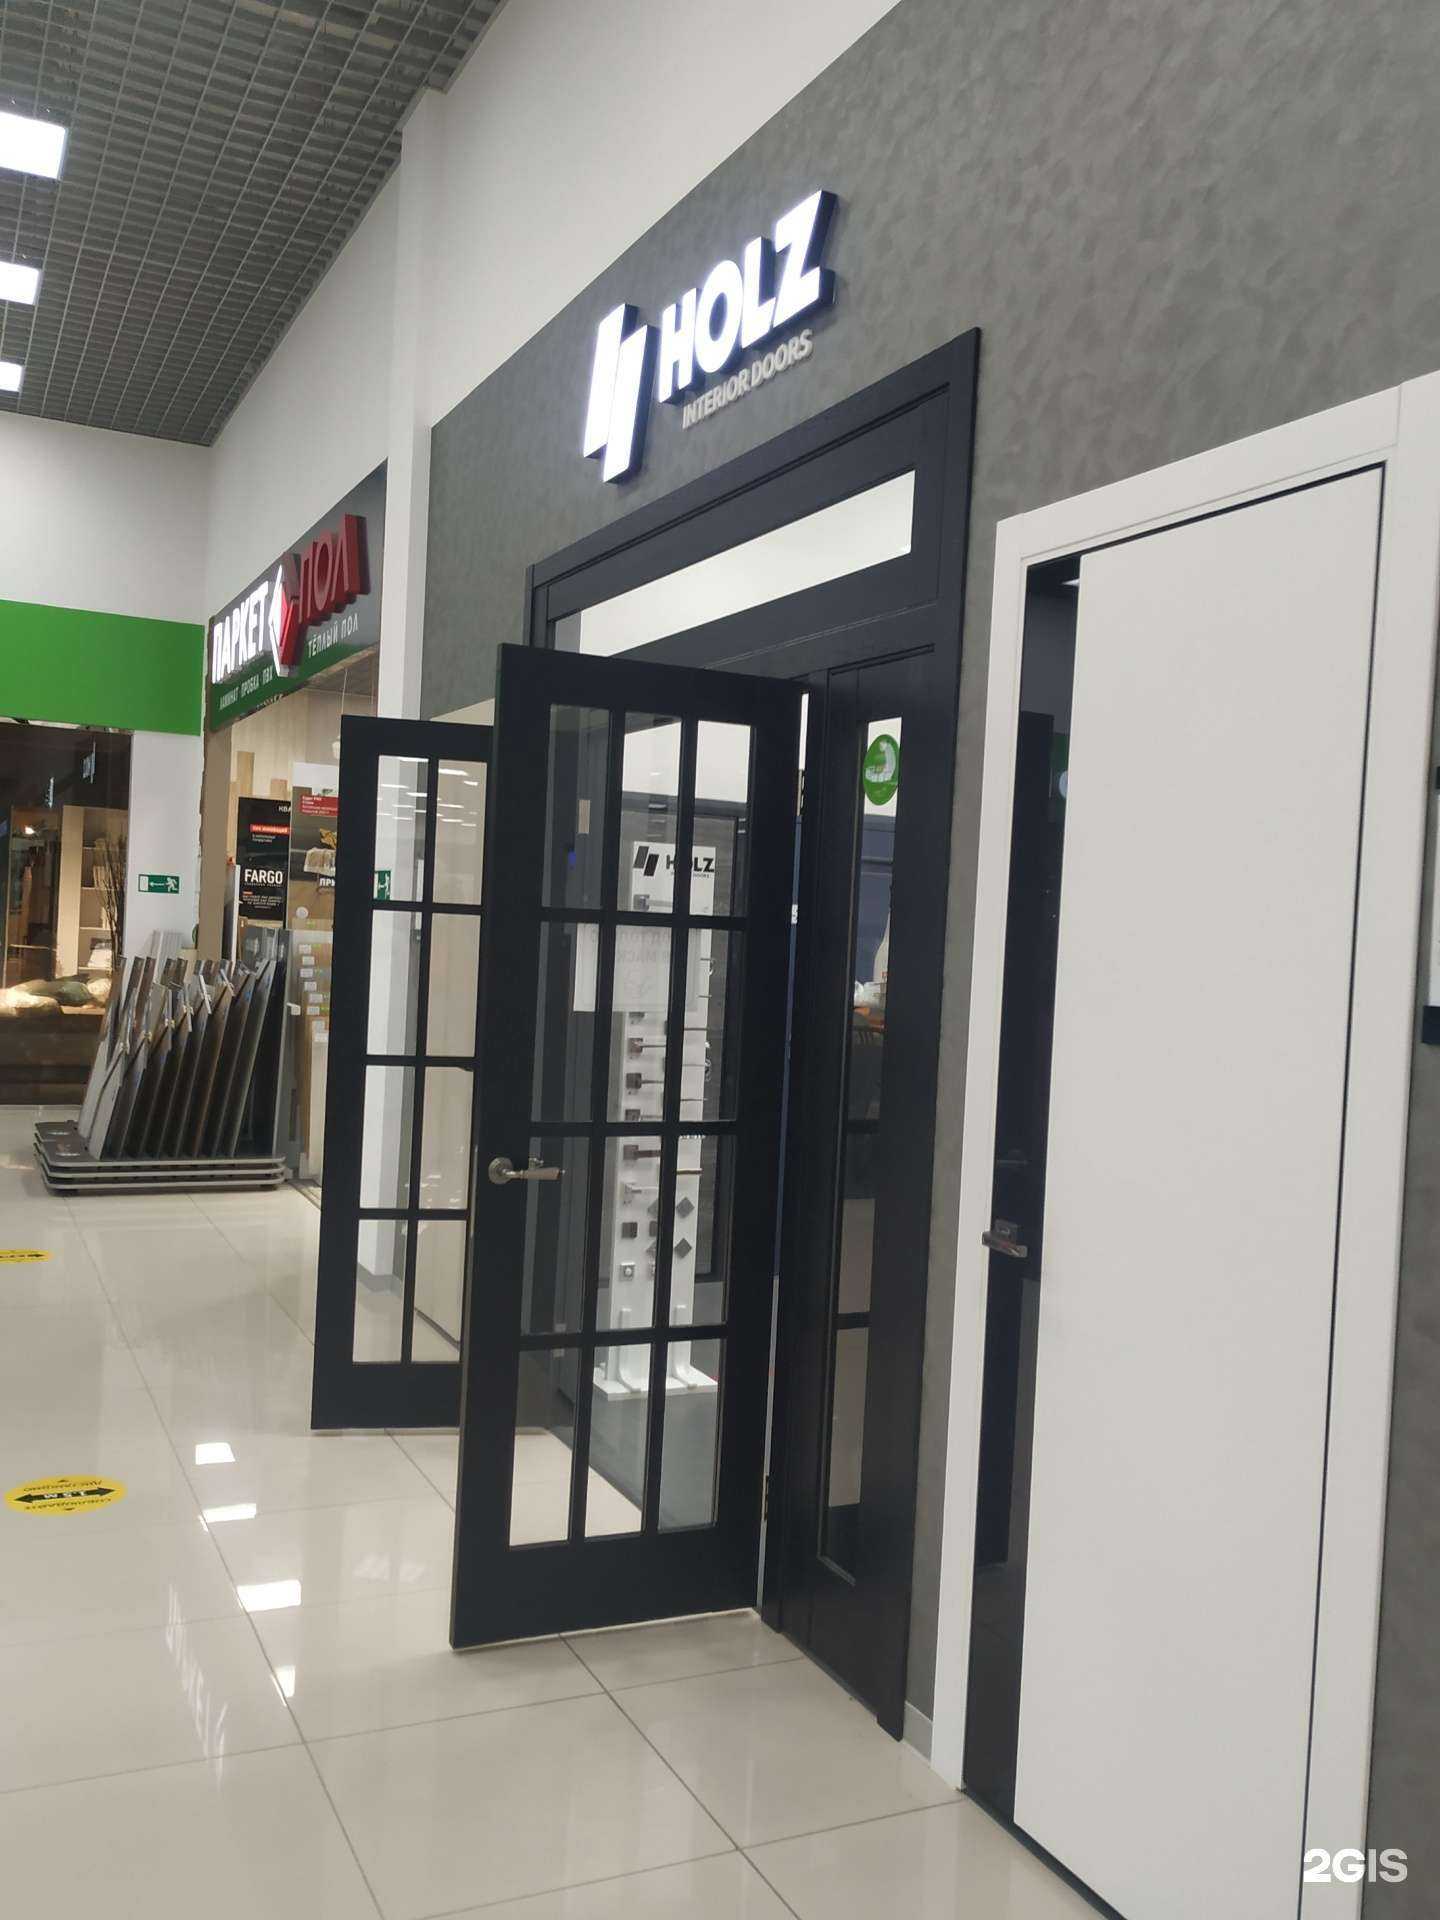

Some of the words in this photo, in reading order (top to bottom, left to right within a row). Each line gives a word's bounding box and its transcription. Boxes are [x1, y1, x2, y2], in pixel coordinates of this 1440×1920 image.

[657, 189, 830, 404] HOLZ
[682, 367, 751, 430] INTERIOR
[750, 328, 814, 388] DOORS
[211, 579, 269, 684] ПАРКЕТ
[298, 514, 363, 624] ПОЛ
[308, 620, 338, 659] ТЁПЛЫЙ
[341, 612, 359, 640] ПОЛ
[244, 868, 283, 884] FARGO
[666, 854, 715, 872] HLZ
